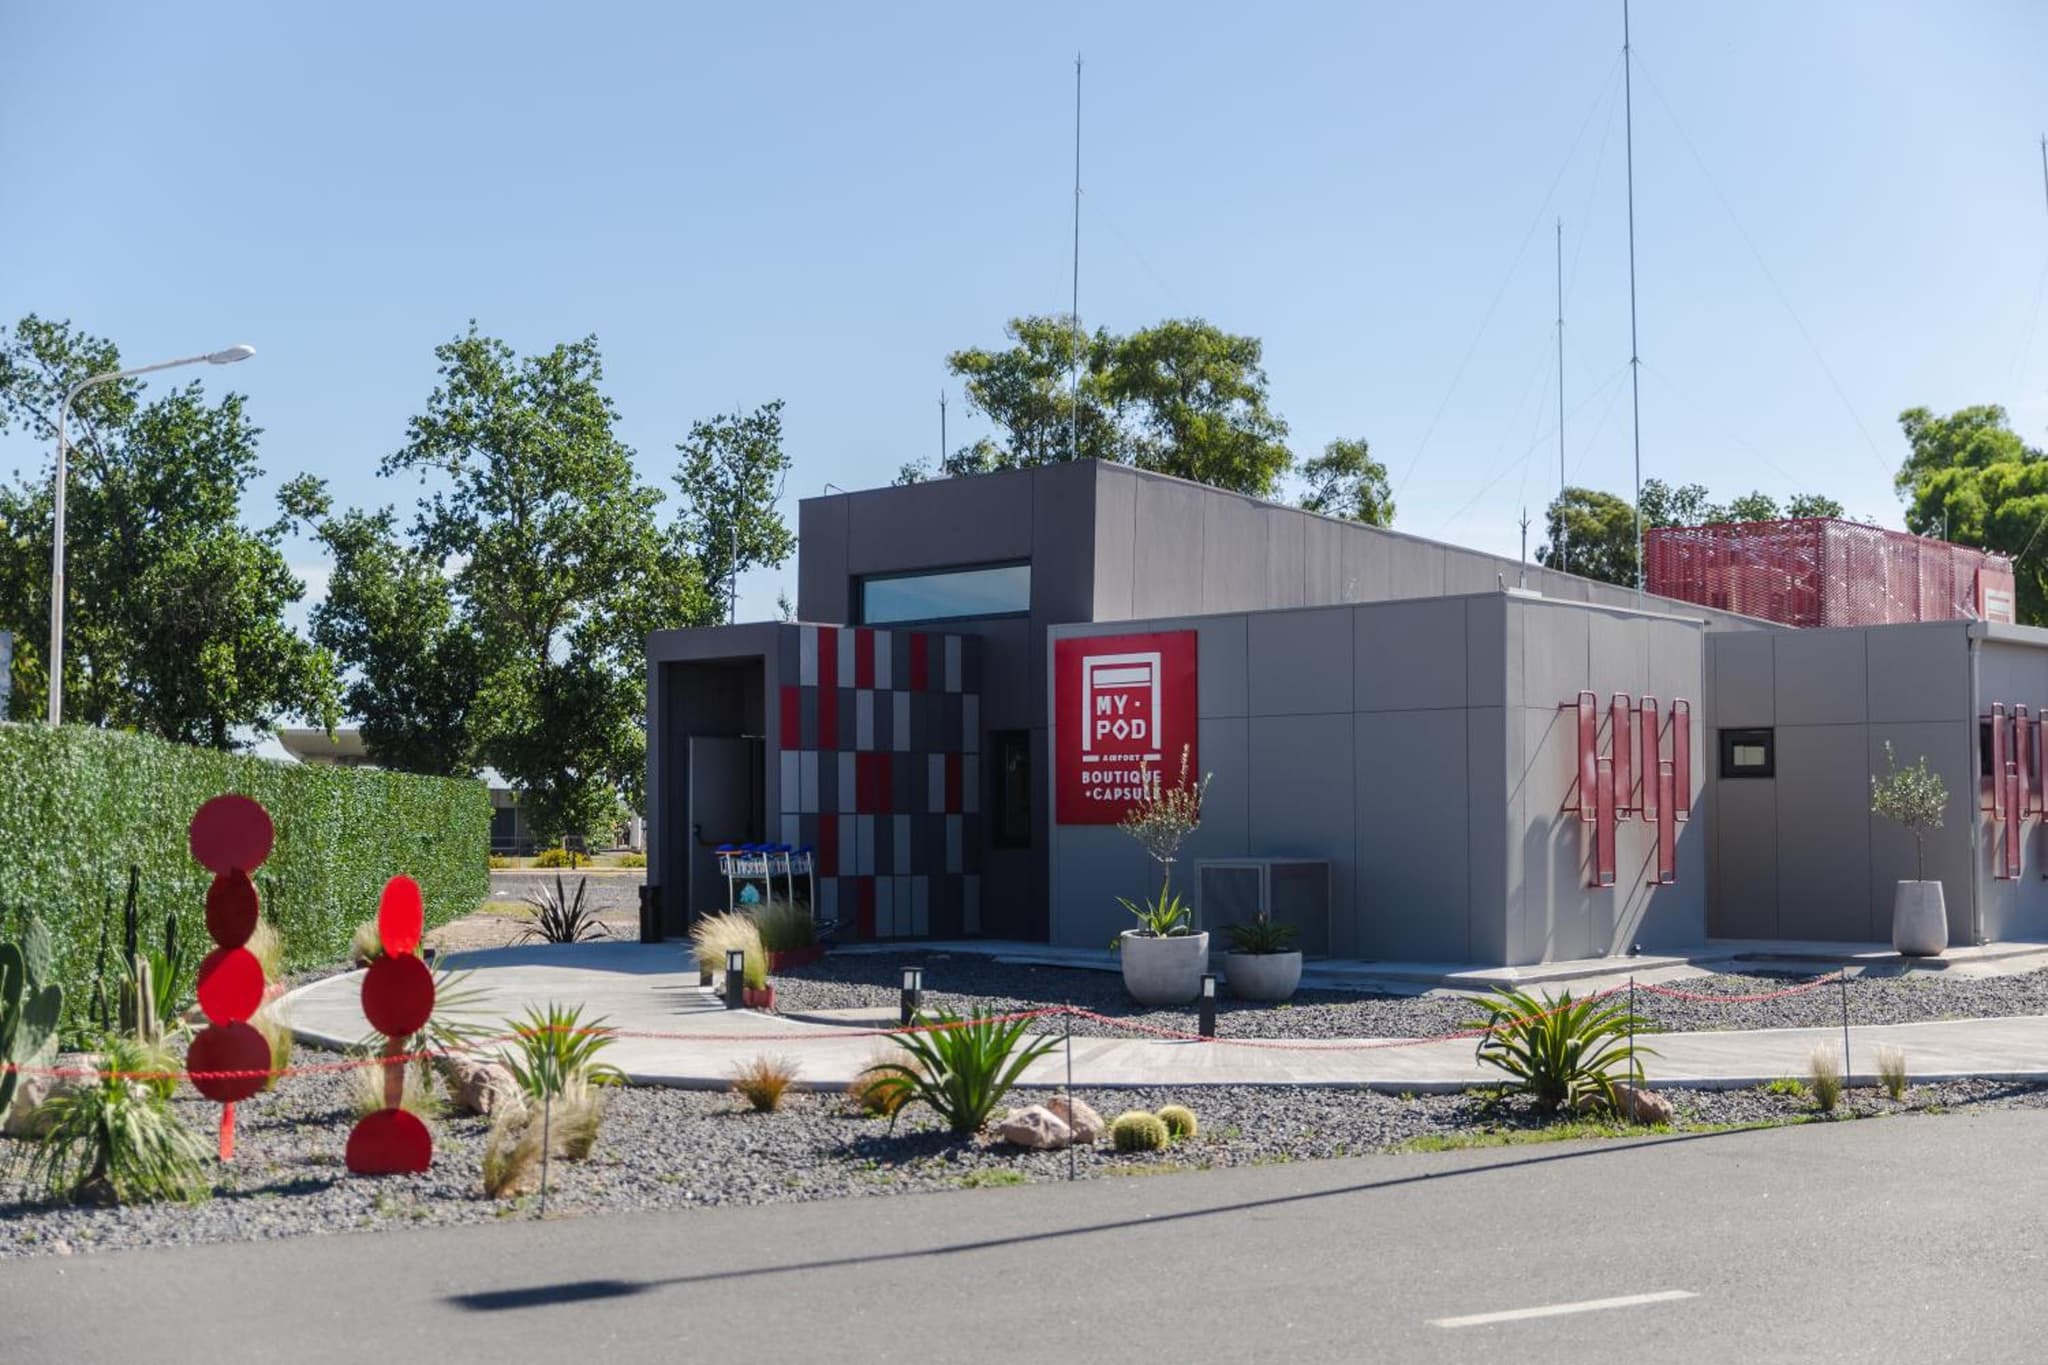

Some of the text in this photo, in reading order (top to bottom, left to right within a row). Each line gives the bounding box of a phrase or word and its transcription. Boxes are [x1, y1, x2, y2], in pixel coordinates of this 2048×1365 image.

[1096, 694, 1128, 715] MY
[1096, 718, 1146, 740] POD
[1082, 770, 1161, 784] BOUTIQUE
